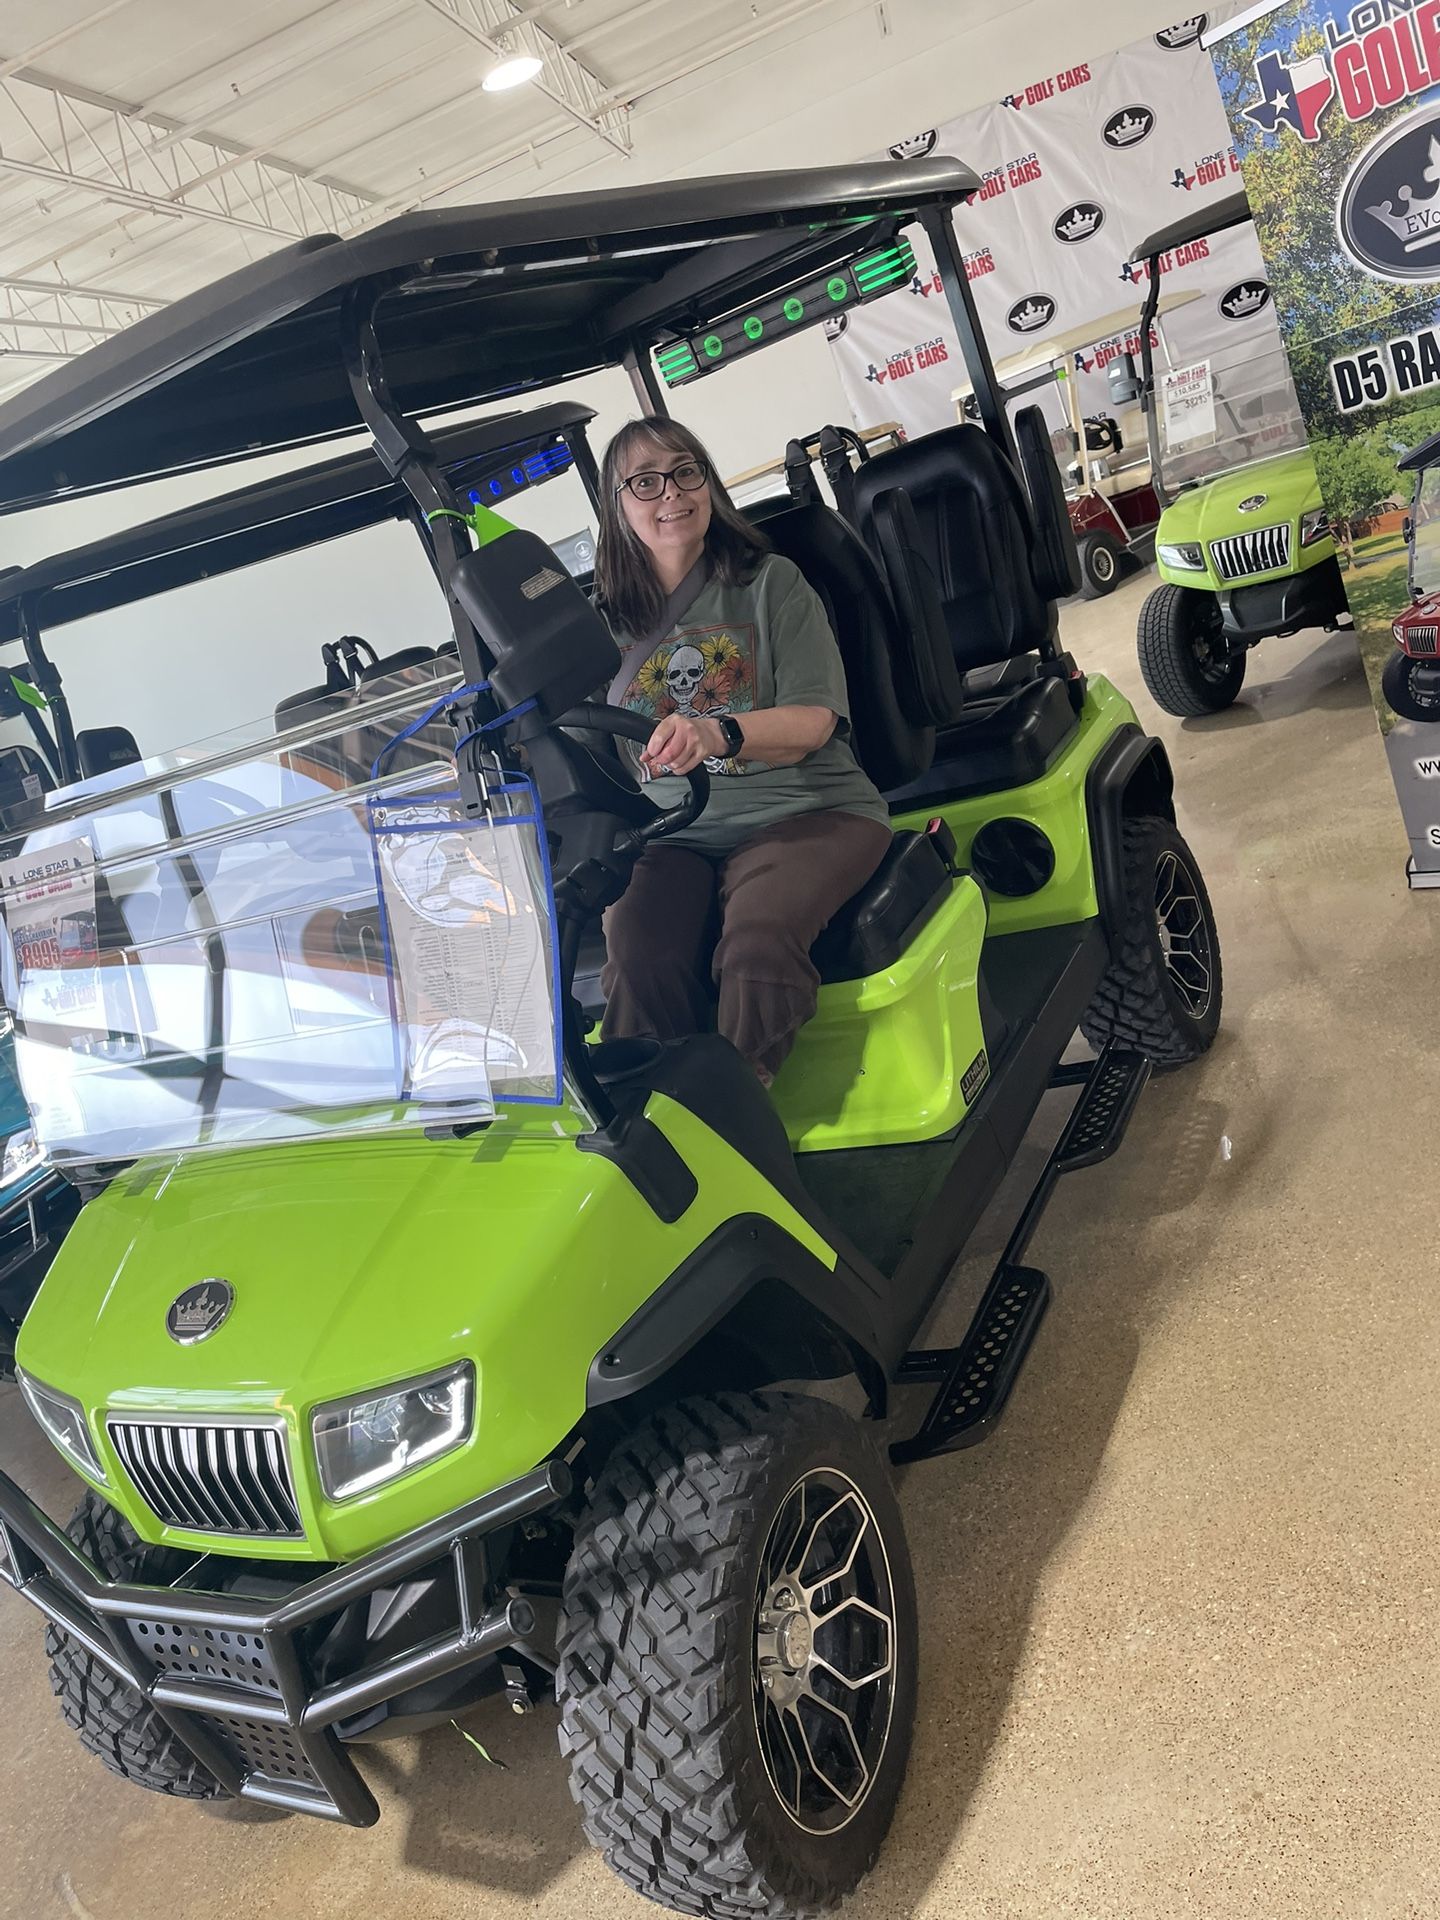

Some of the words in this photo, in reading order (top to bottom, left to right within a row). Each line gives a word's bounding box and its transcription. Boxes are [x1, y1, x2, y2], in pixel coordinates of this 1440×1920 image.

[1024, 78, 1054, 106] GOLF
[1056, 63, 1091, 92] CARS
[981, 166, 1004, 181] ONE
[1006, 152, 1037, 170] STAR
[1194, 150, 1223, 168] LONE
[1196, 158, 1226, 186] GOLF
[1008, 160, 1042, 189] CARS
[962, 247, 991, 264] STAR
[1175, 238, 1210, 267] CARS
[962, 254, 996, 281] CARS
[885, 349, 912, 364] LONE
[914, 337, 943, 353] STAR
[1093, 336, 1120, 352] LONE
[887, 355, 914, 381] GOLF
[916, 343, 948, 369] CARS
[1333, 350, 1387, 410] D5
[1390, 330, 1440, 392] RA
[22, 866, 43, 880] LONE
[45, 859, 69, 873] STAR
